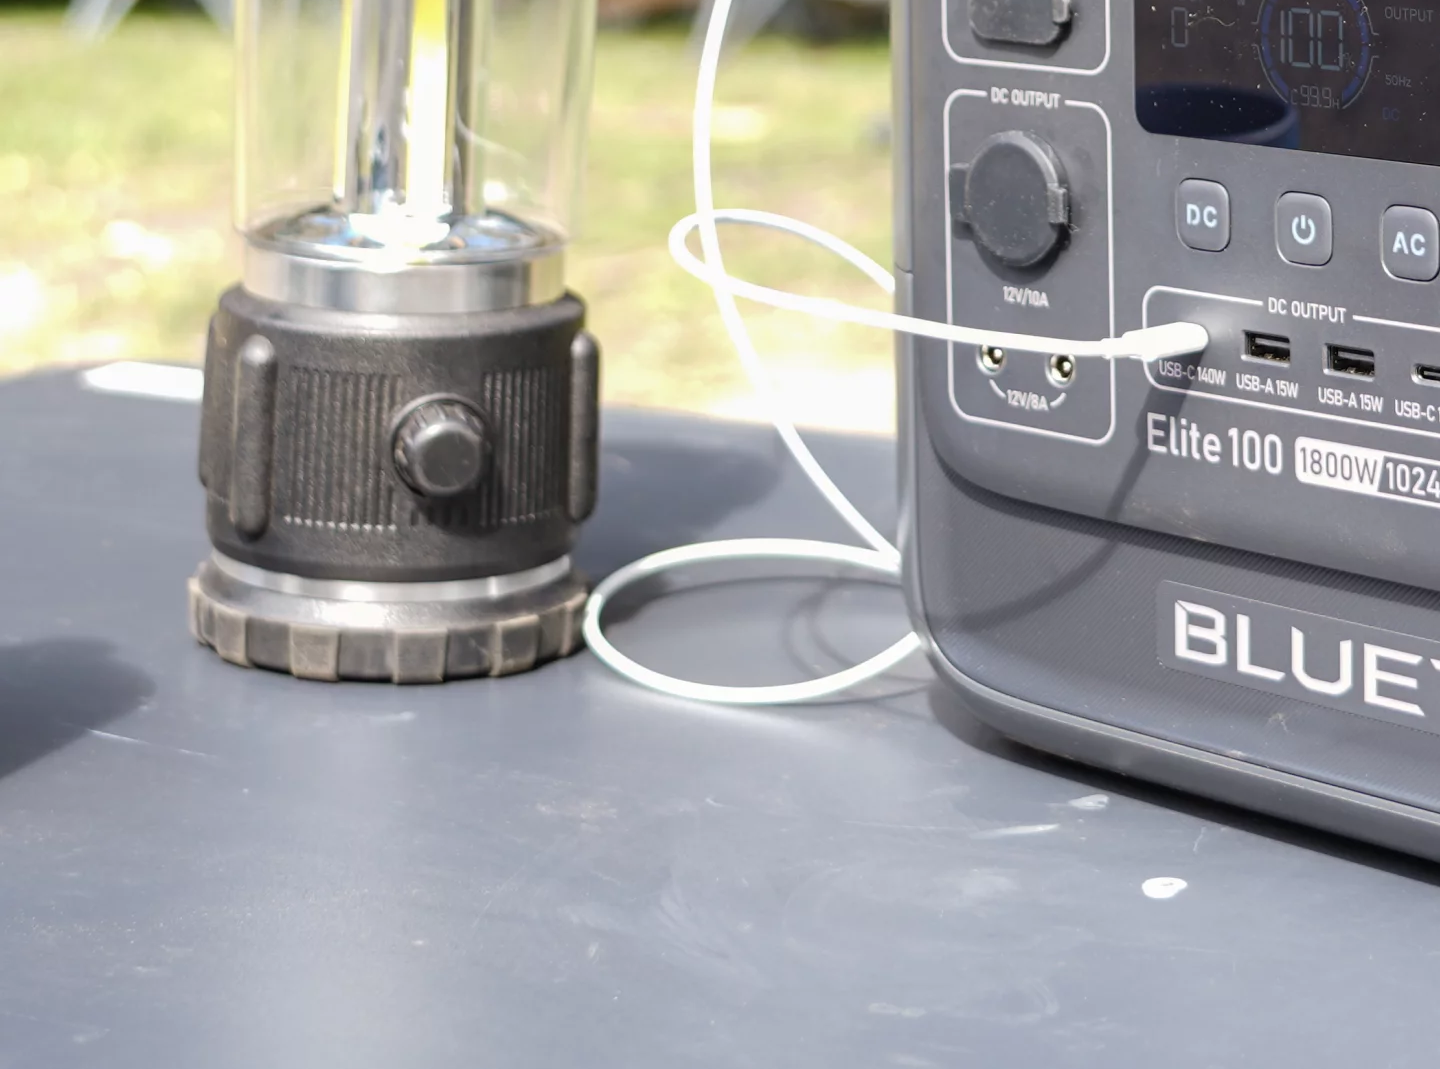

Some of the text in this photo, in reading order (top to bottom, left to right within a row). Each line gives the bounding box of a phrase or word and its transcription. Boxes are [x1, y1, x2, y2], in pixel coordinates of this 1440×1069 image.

[1384, 6, 1434, 23] OUTPUT
[991, 87, 1061, 109] DC OUTPUT
[1382, 107, 1401, 122] DC
[1186, 204, 1217, 227] DC
[1393, 231, 1426, 256] AC
[1003, 286, 1049, 307] 12V/10A
[1268, 297, 1346, 323] DC OUTPUT
[1159, 360, 1226, 386] USB-C 140W
[1236, 373, 1298, 399] USB-A 15W
[1006, 389, 1049, 411] 12V/8A
[1318, 387, 1383, 413] USB-A 15W
[1395, 399, 1436, 421] USB-C
[1147, 411, 1221, 462] Elite
[1227, 427, 1282, 474] 100
[1300, 446, 1381, 485] 1800W
